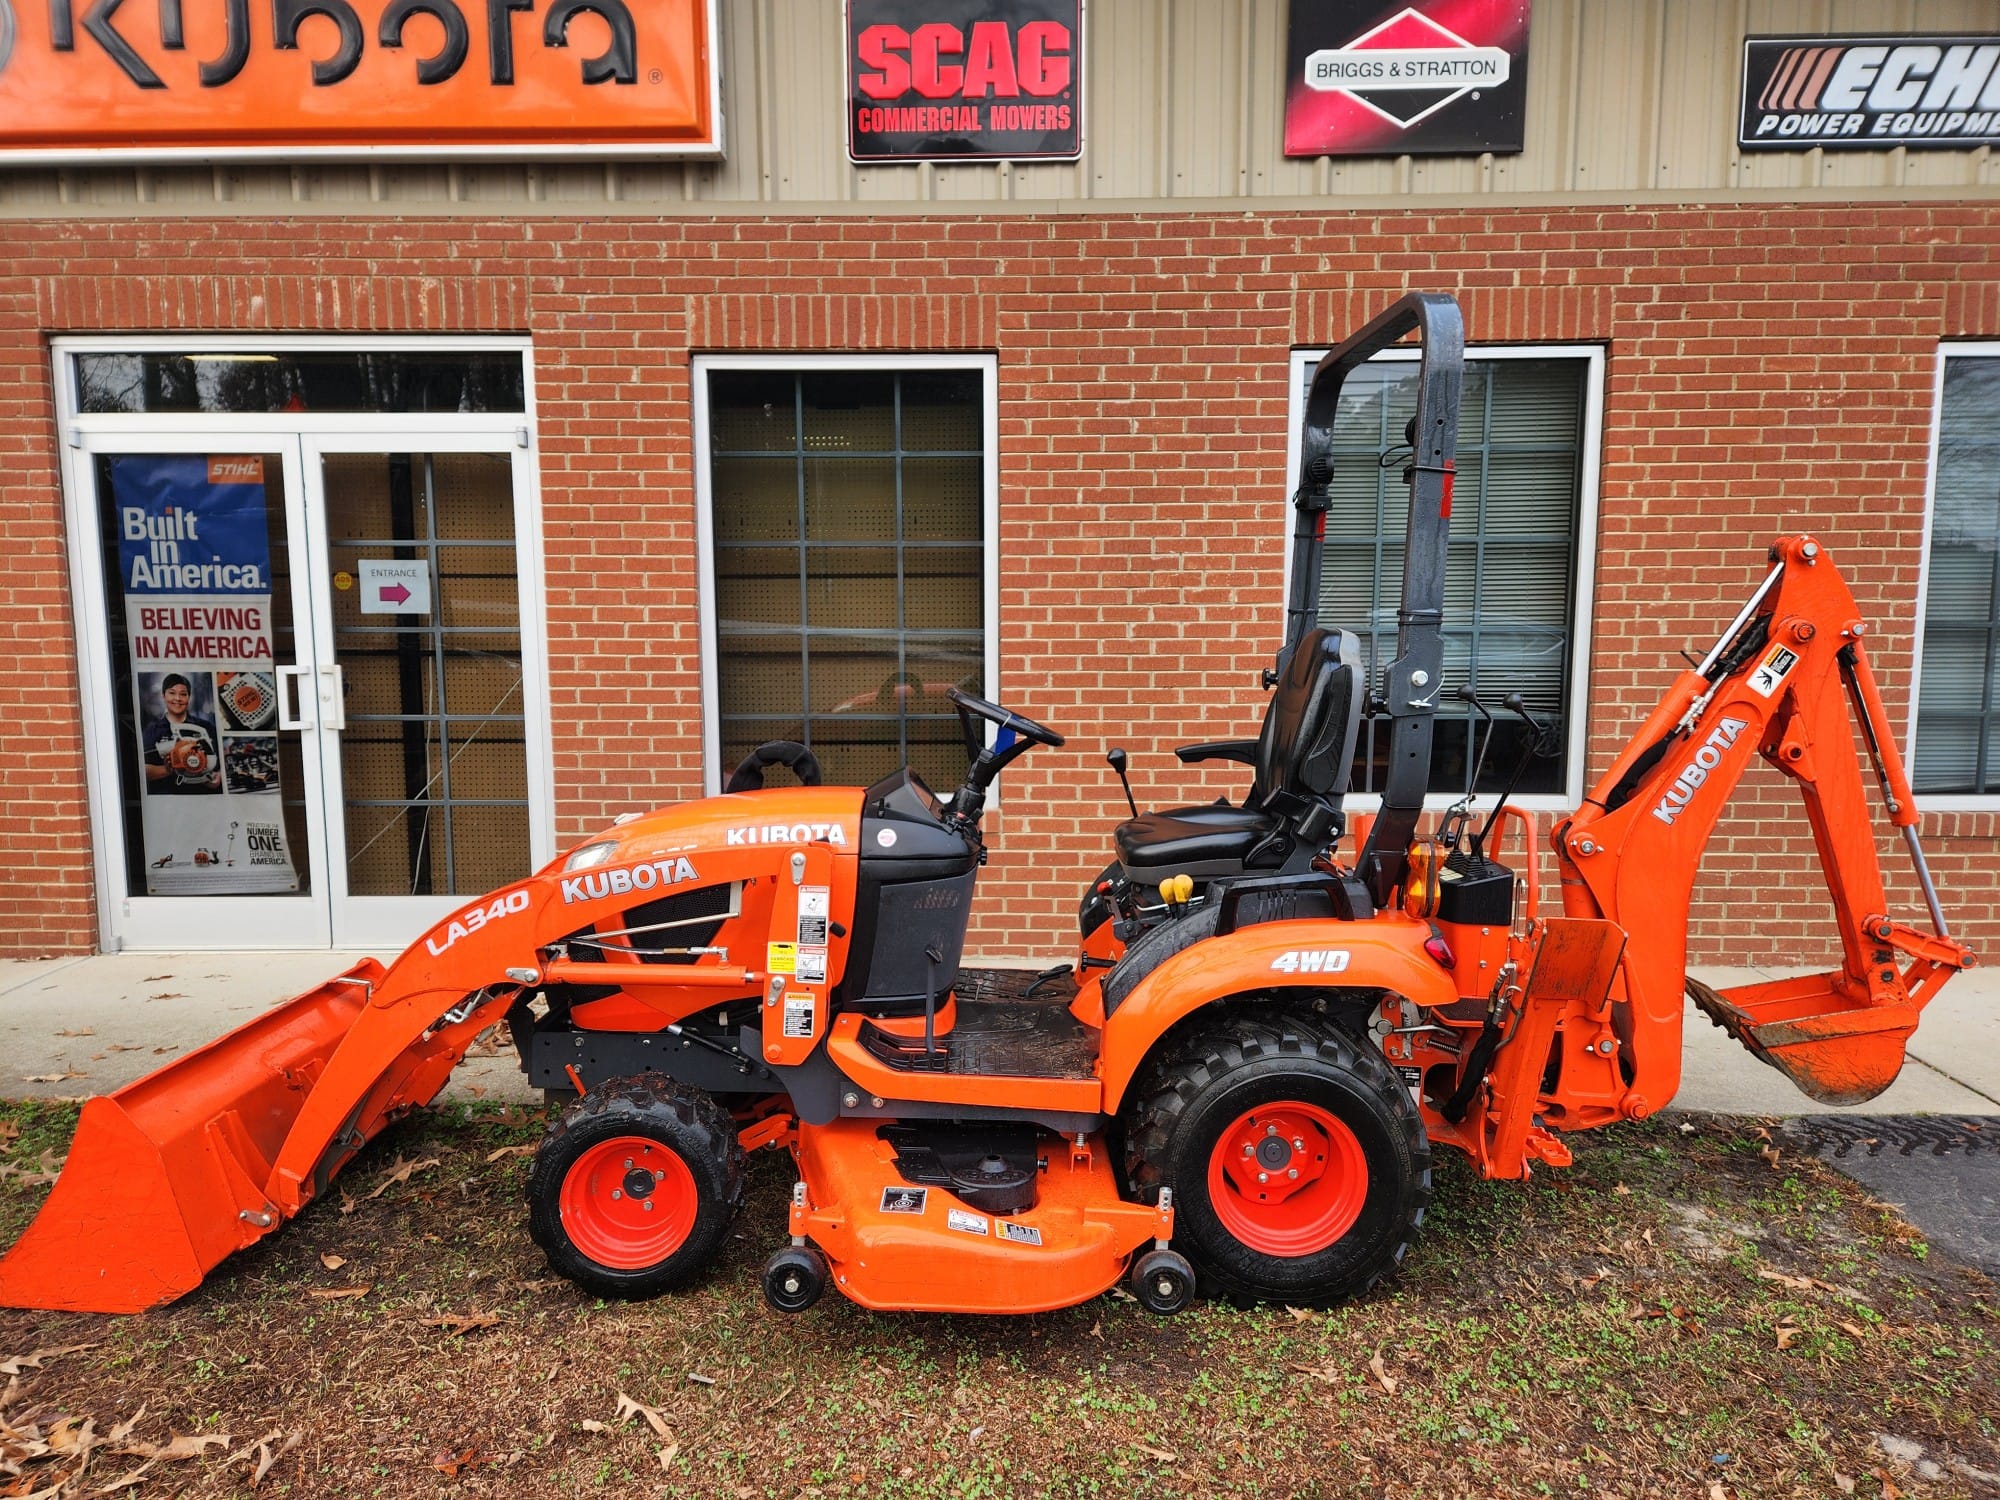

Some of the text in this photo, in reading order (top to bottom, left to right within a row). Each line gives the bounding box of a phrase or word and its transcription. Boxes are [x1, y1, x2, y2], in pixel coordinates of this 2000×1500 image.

[858, 21, 1070, 99] SCAG
[1316, 60, 1496, 78] BRIGGS & STRATTON
[1821, 45, 2000, 110] ECH
[858, 105, 1071, 132] COMMERCIAL MOWERS
[1755, 113, 1866, 135] POWER
[212, 463, 258, 476] STIHL
[122, 506, 199, 540] Built
[150, 540, 179, 564] in
[130, 555, 267, 589] America.
[371, 568, 417, 577] ENTRANCE
[140, 607, 261, 630] BELIEVING
[135, 636, 272, 659] IN AMERICA
[1652, 716, 1748, 825] KUBOTA
[247, 827, 279, 837] NUMBER
[247, 835, 284, 851] ONE
[560, 855, 700, 904] KUBOTA
[425, 889, 530, 957] LA340
[1270, 949, 1350, 973] 4WD
